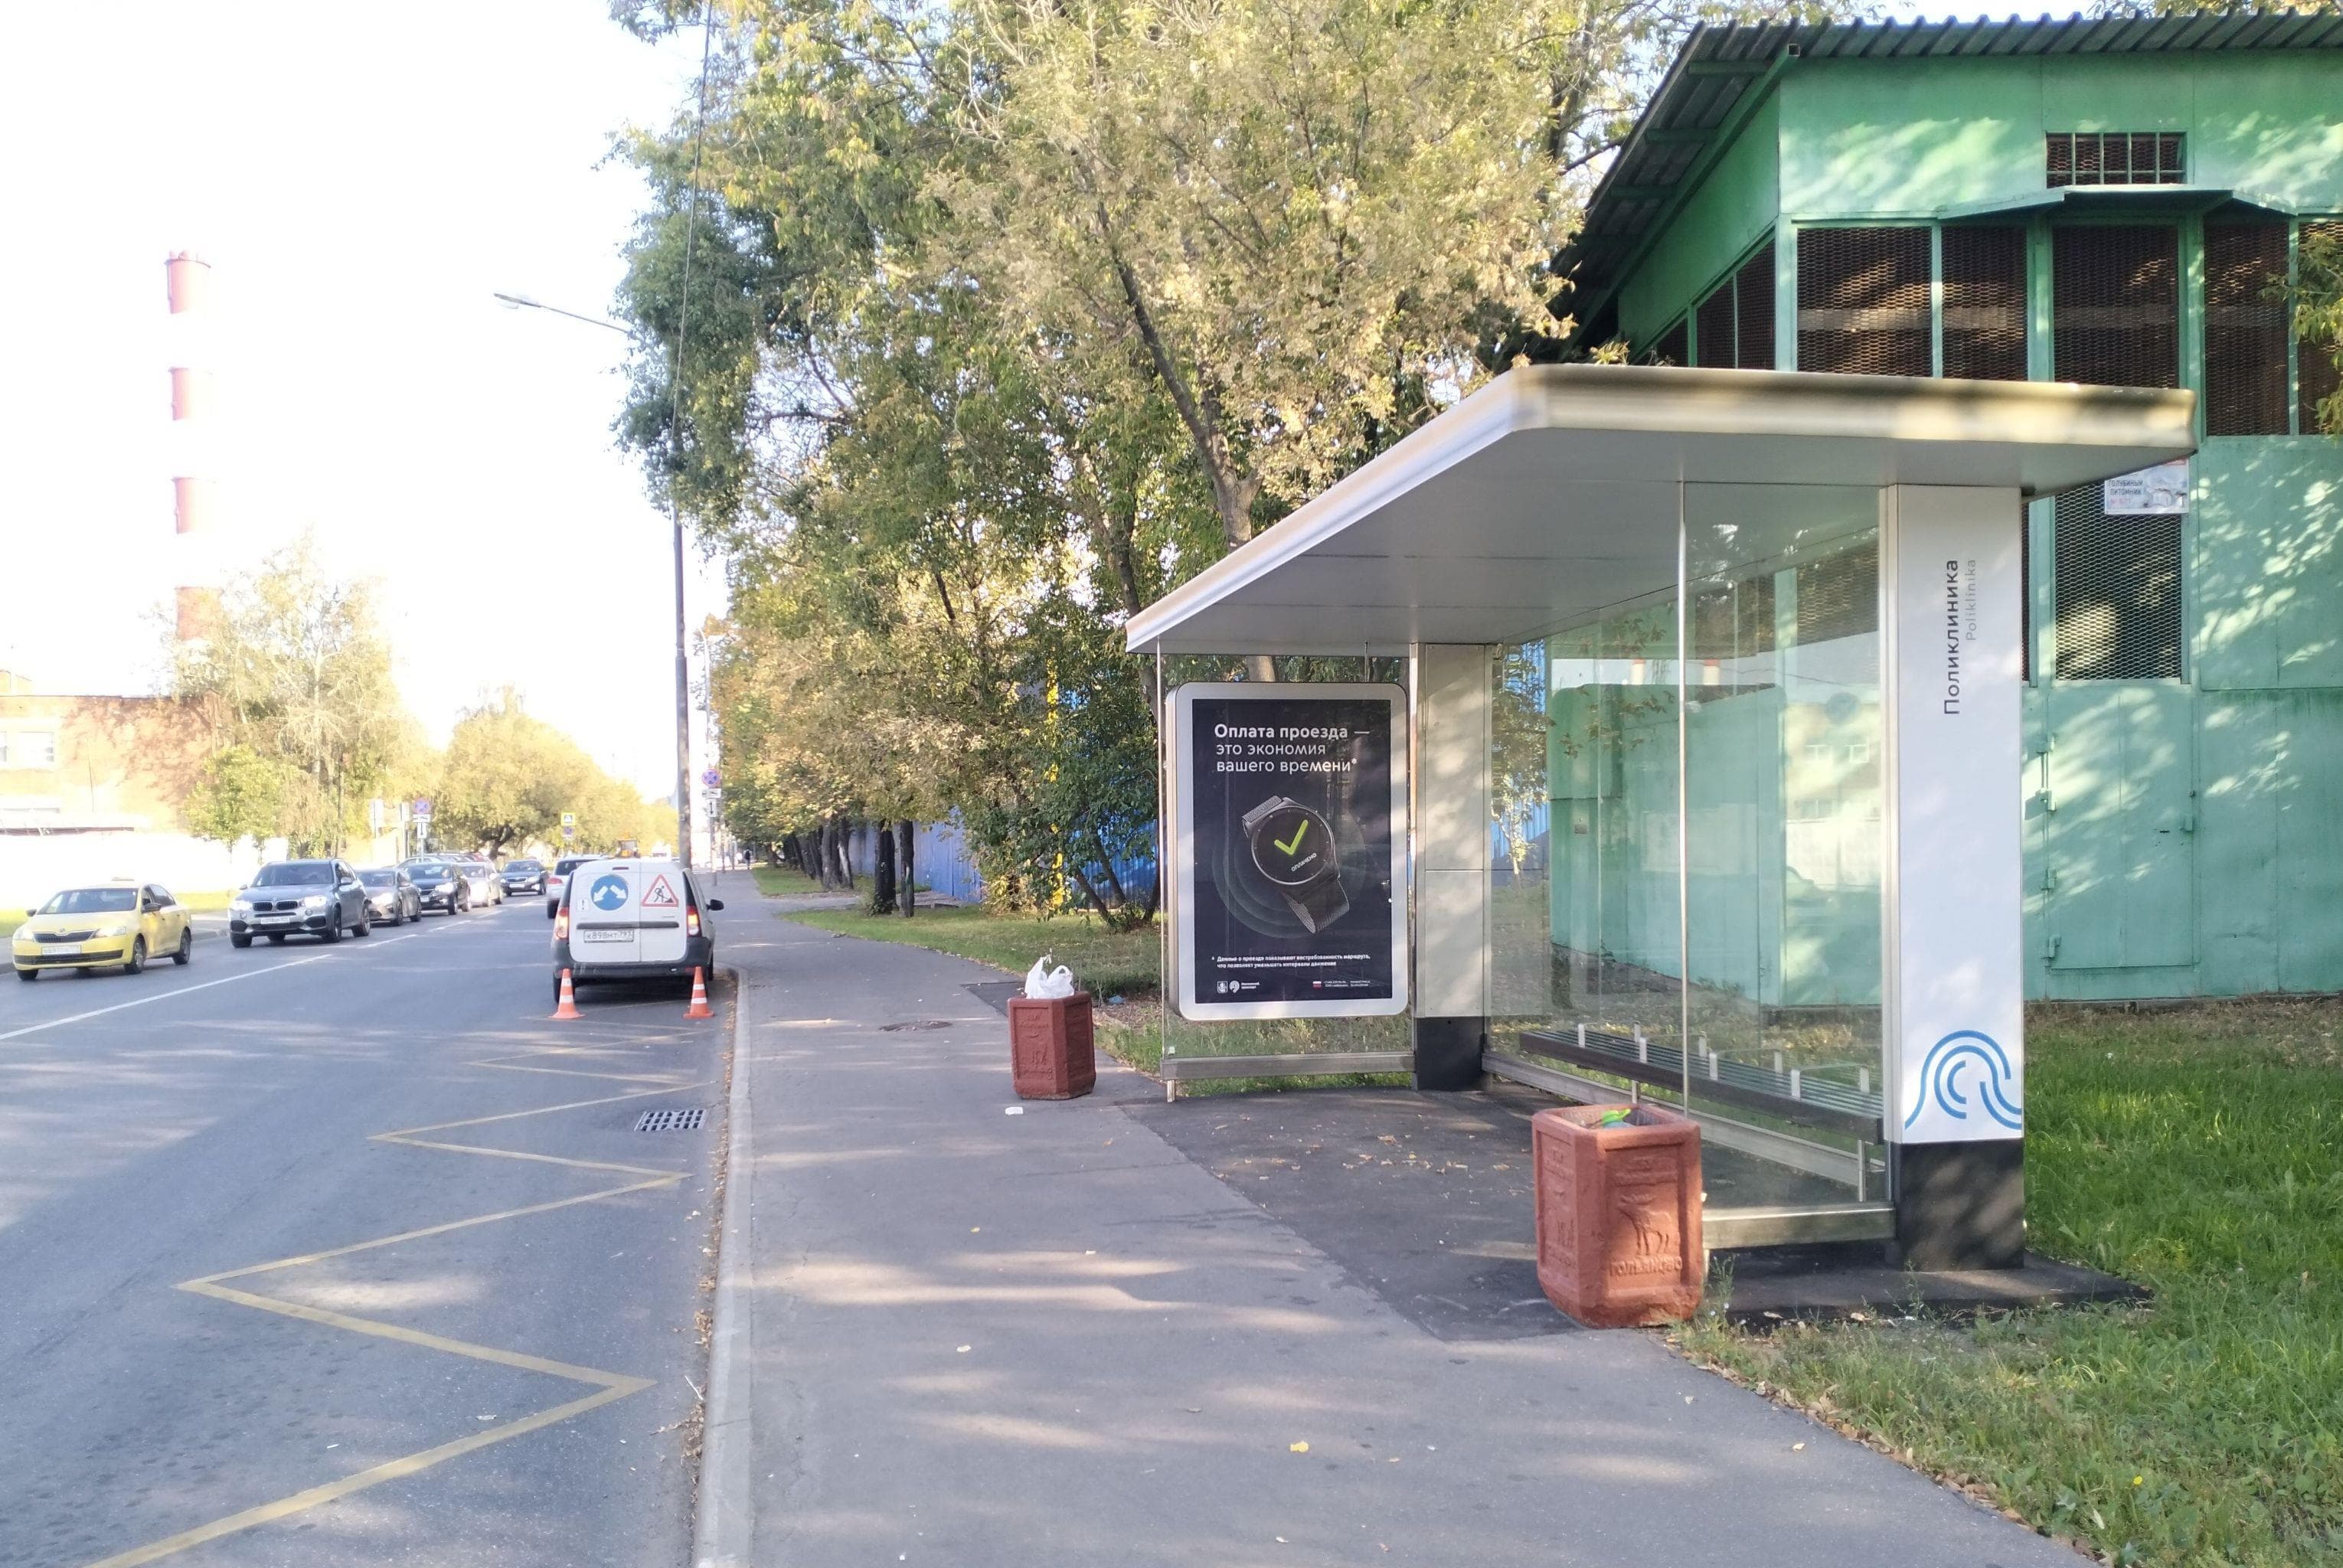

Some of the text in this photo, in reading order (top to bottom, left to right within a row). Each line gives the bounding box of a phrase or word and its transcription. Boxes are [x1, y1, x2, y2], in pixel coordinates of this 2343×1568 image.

[1965, 560, 1977, 641] Poliklinika
[1943, 560, 1960, 714] Поликлиника
[1214, 724, 1275, 738] Оплата
[1279, 727, 1348, 741] проезда
[1216, 744, 1326, 756] это экономия
[1217, 761, 1275, 773] вашего
